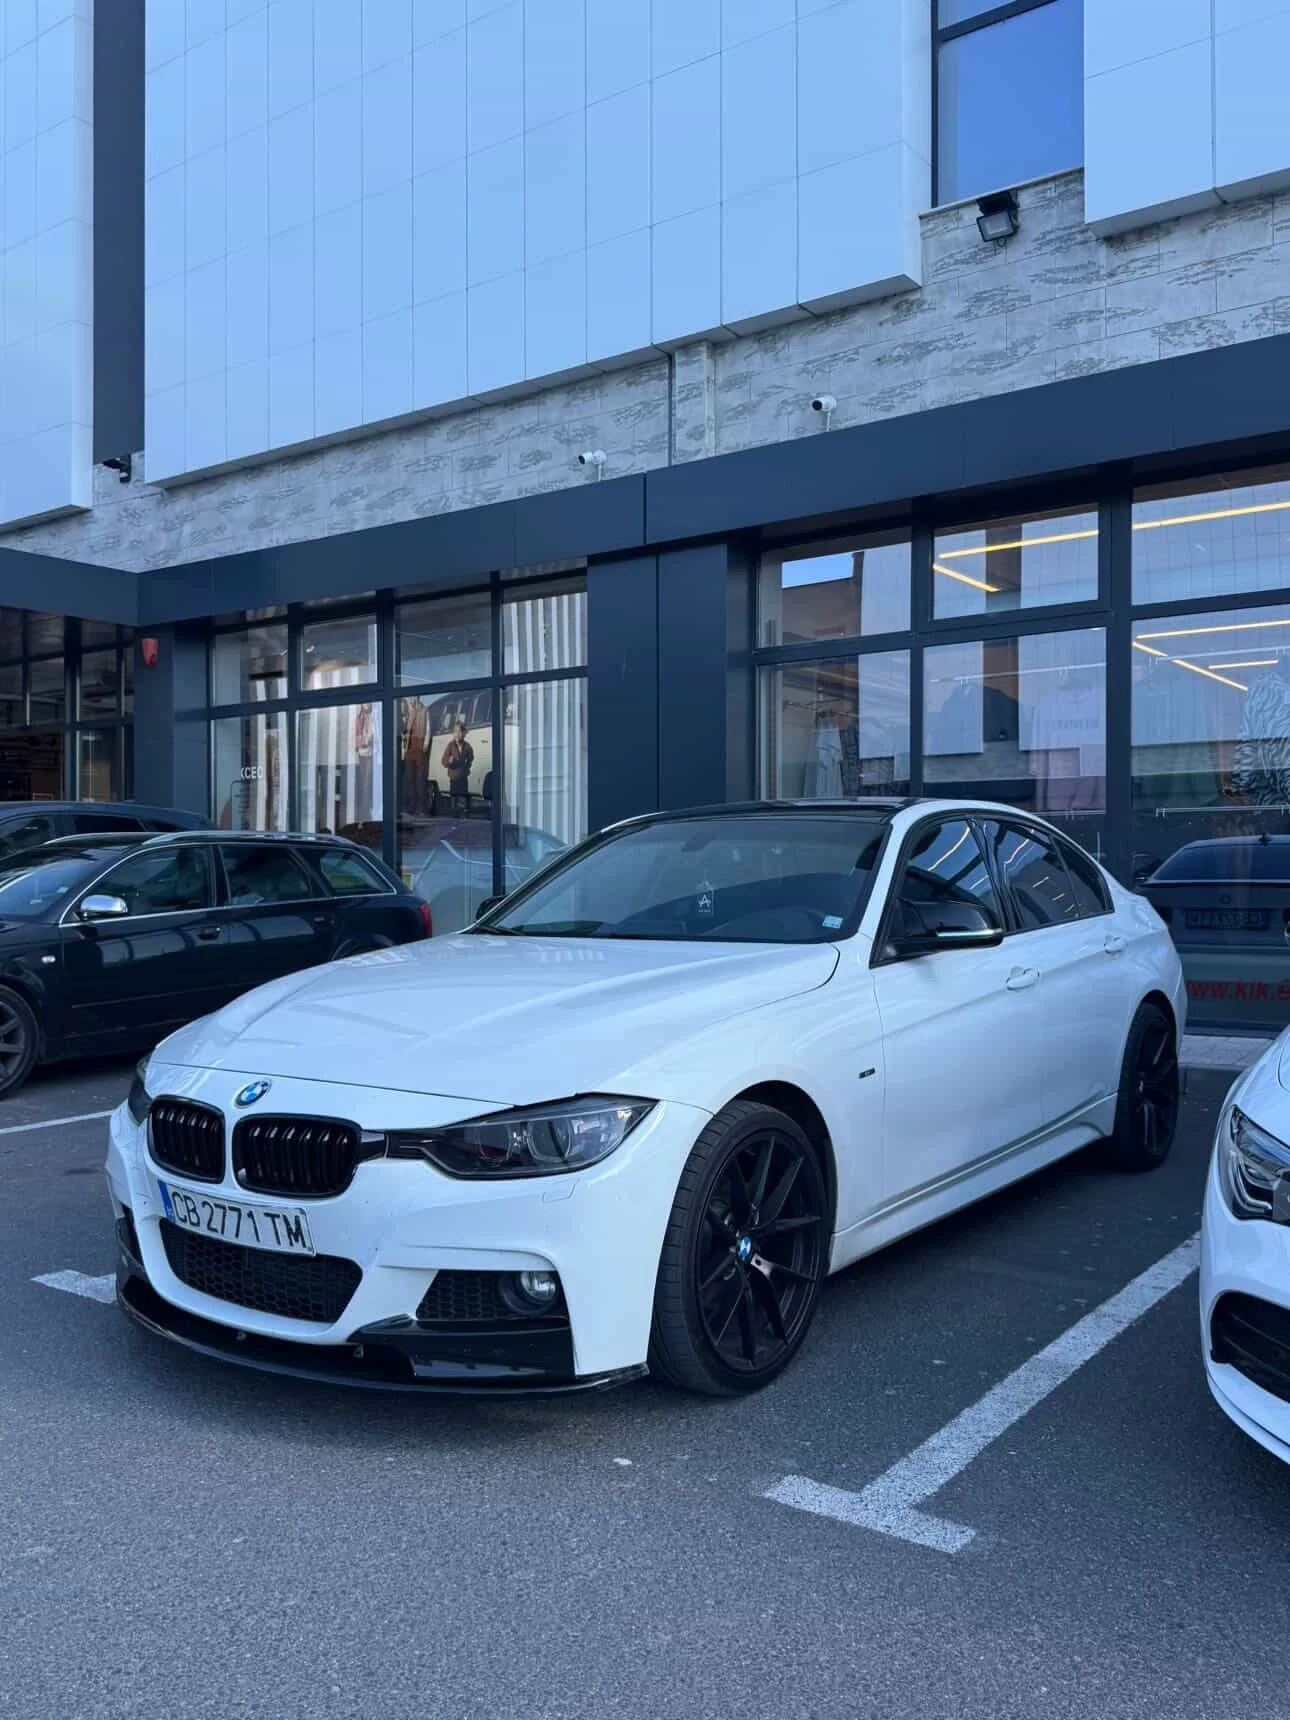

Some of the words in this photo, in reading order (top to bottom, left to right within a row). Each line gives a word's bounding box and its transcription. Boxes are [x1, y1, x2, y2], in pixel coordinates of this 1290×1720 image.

[171, 1191, 201, 1227] CB
[202, 1201, 260, 1243] 2771
[264, 1212, 307, 1248] TM
